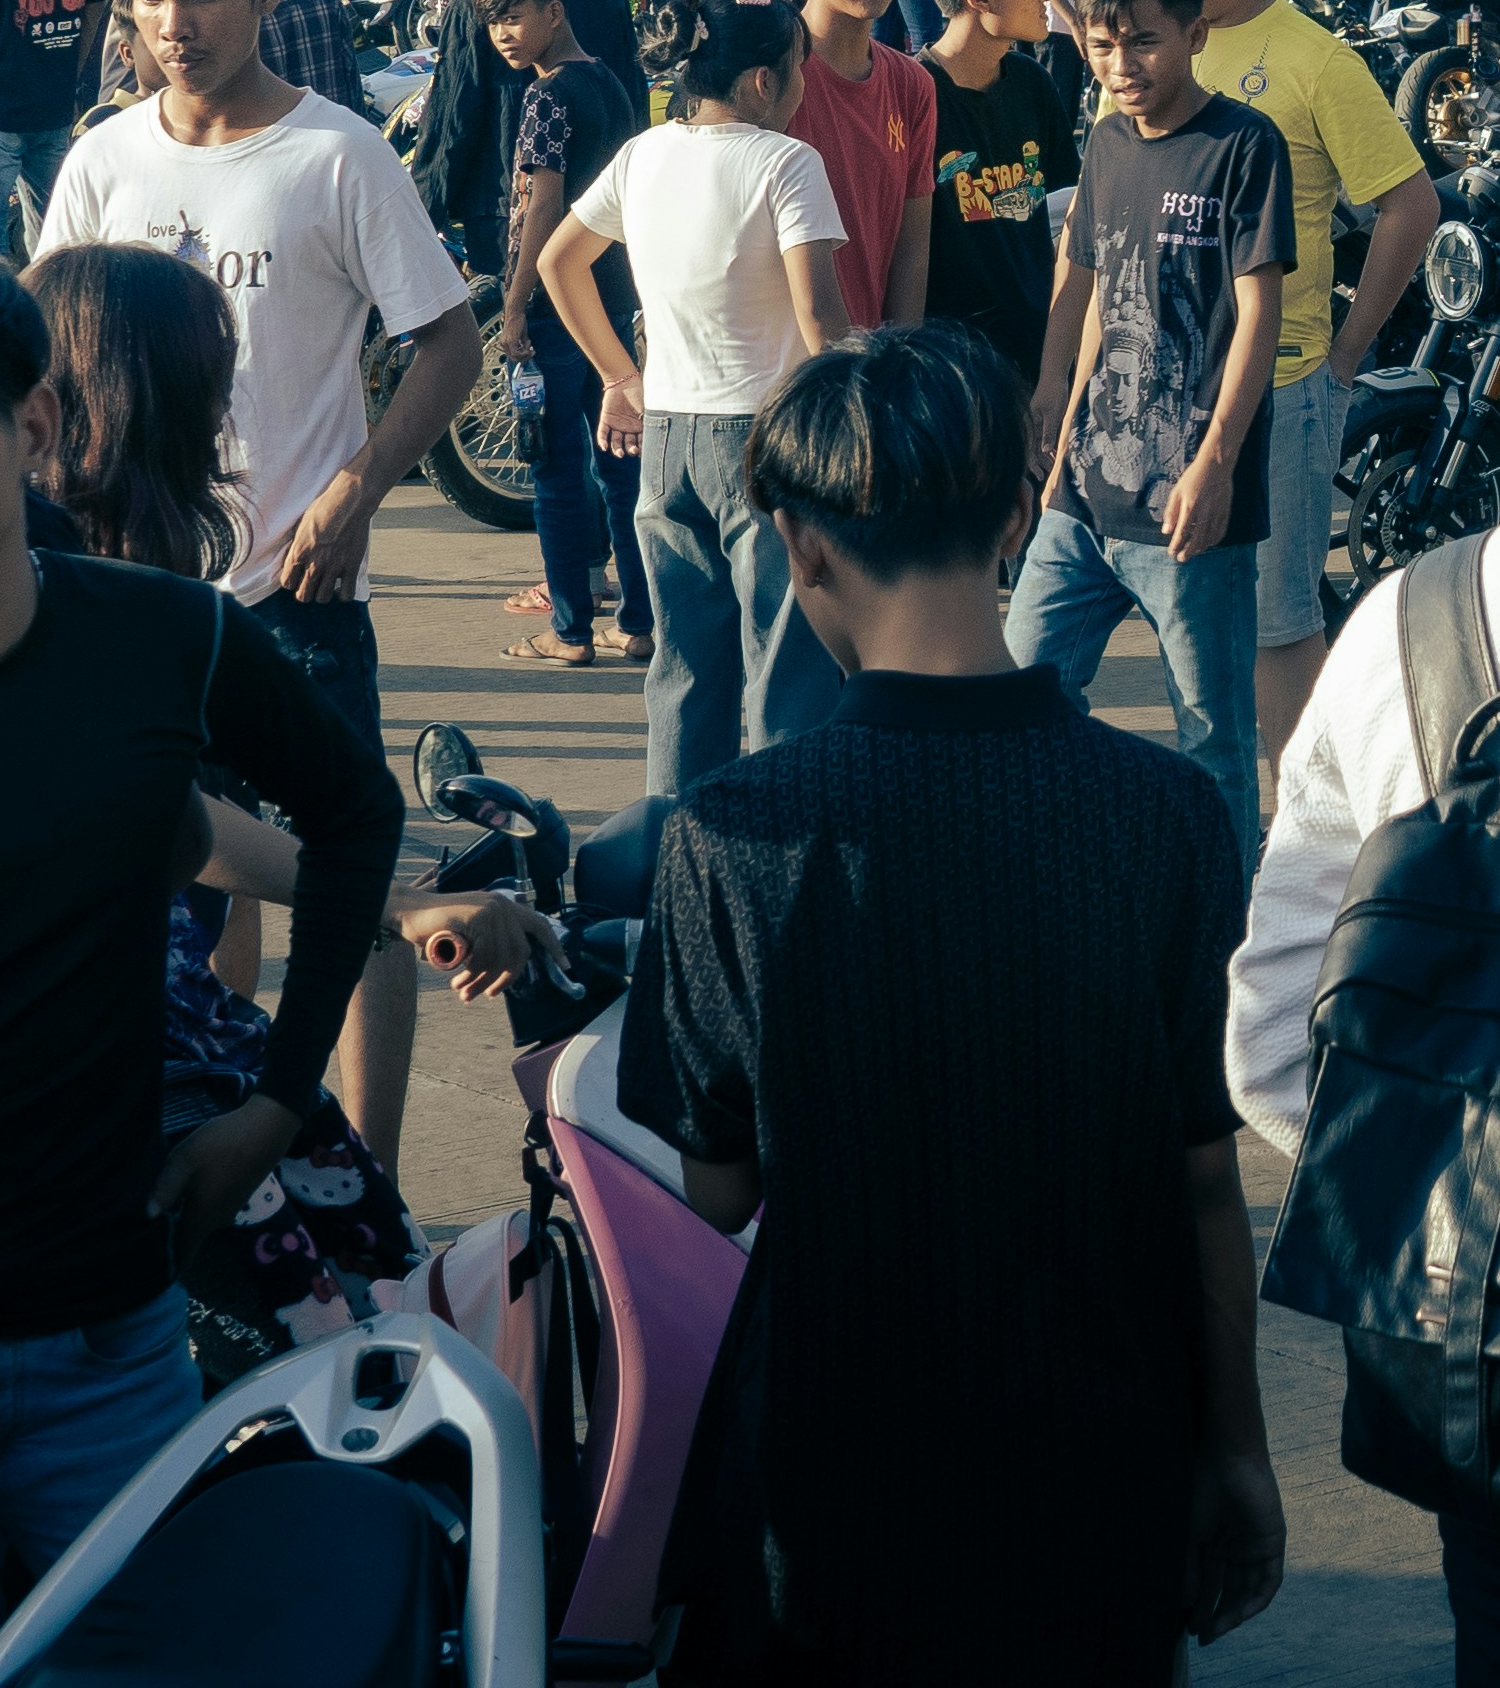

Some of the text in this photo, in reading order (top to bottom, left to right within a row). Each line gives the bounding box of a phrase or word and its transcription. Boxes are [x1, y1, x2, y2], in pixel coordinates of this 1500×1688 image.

[147, 220, 177, 239] love
[1156, 232, 1220, 247] KHMER ANGKOR
